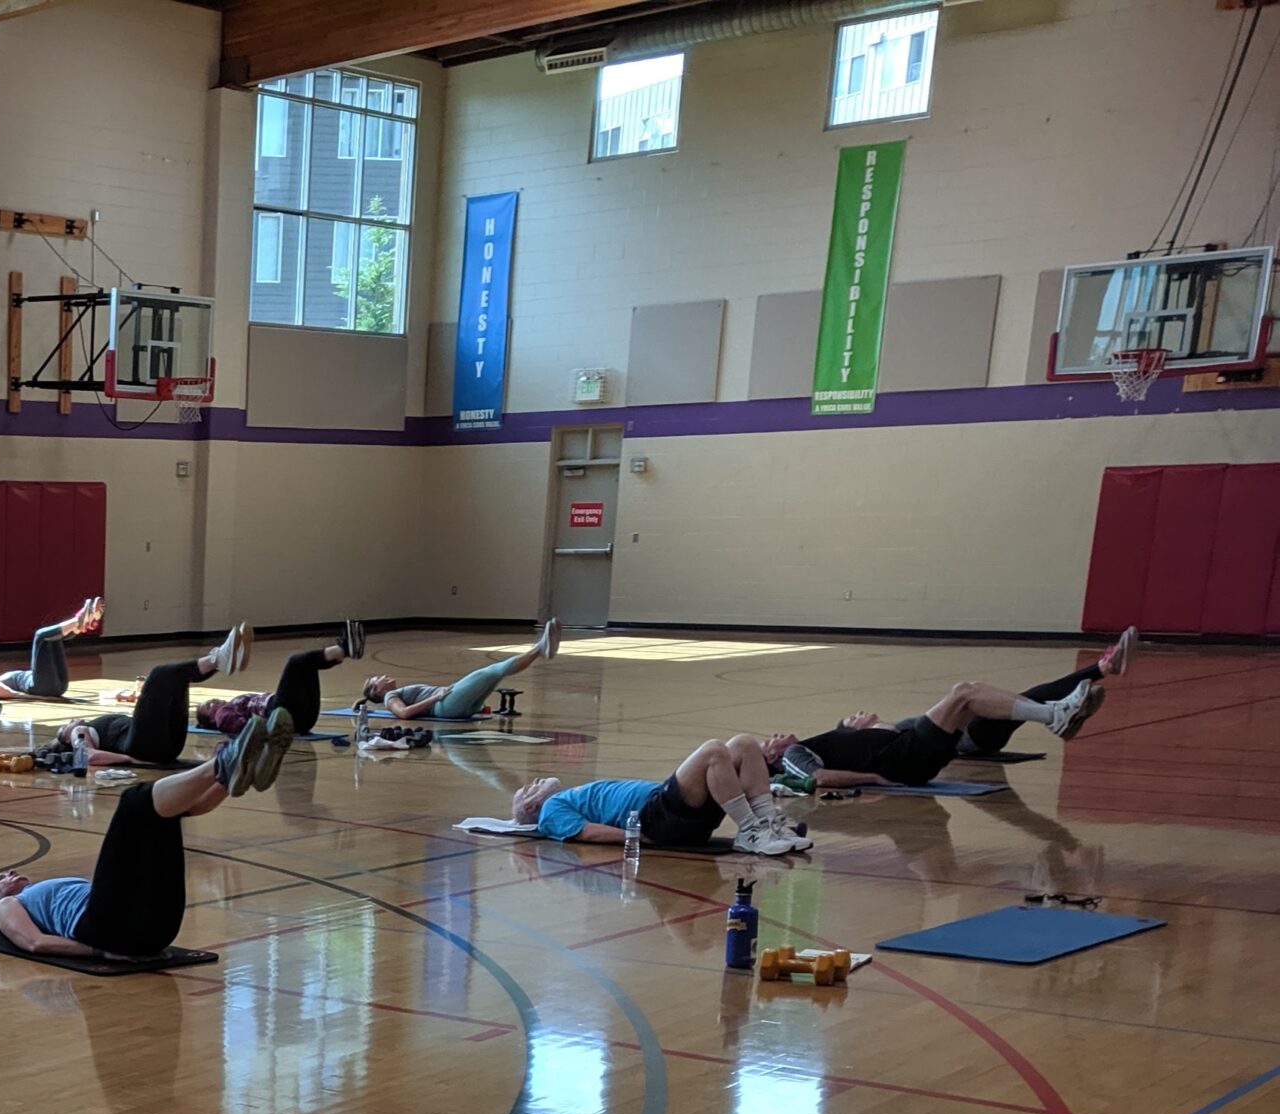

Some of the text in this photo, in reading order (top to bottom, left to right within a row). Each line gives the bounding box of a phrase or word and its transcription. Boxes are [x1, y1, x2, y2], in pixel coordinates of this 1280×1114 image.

[841, 150, 877, 383] RESPONSIBILITY
[475, 218, 495, 378] HONESTY
[815, 389, 874, 400] RESPONSIBILITY
[460, 408, 495, 420] HONESTY
[571, 507, 602, 515] Emergency
[586, 516, 599, 524] Only
